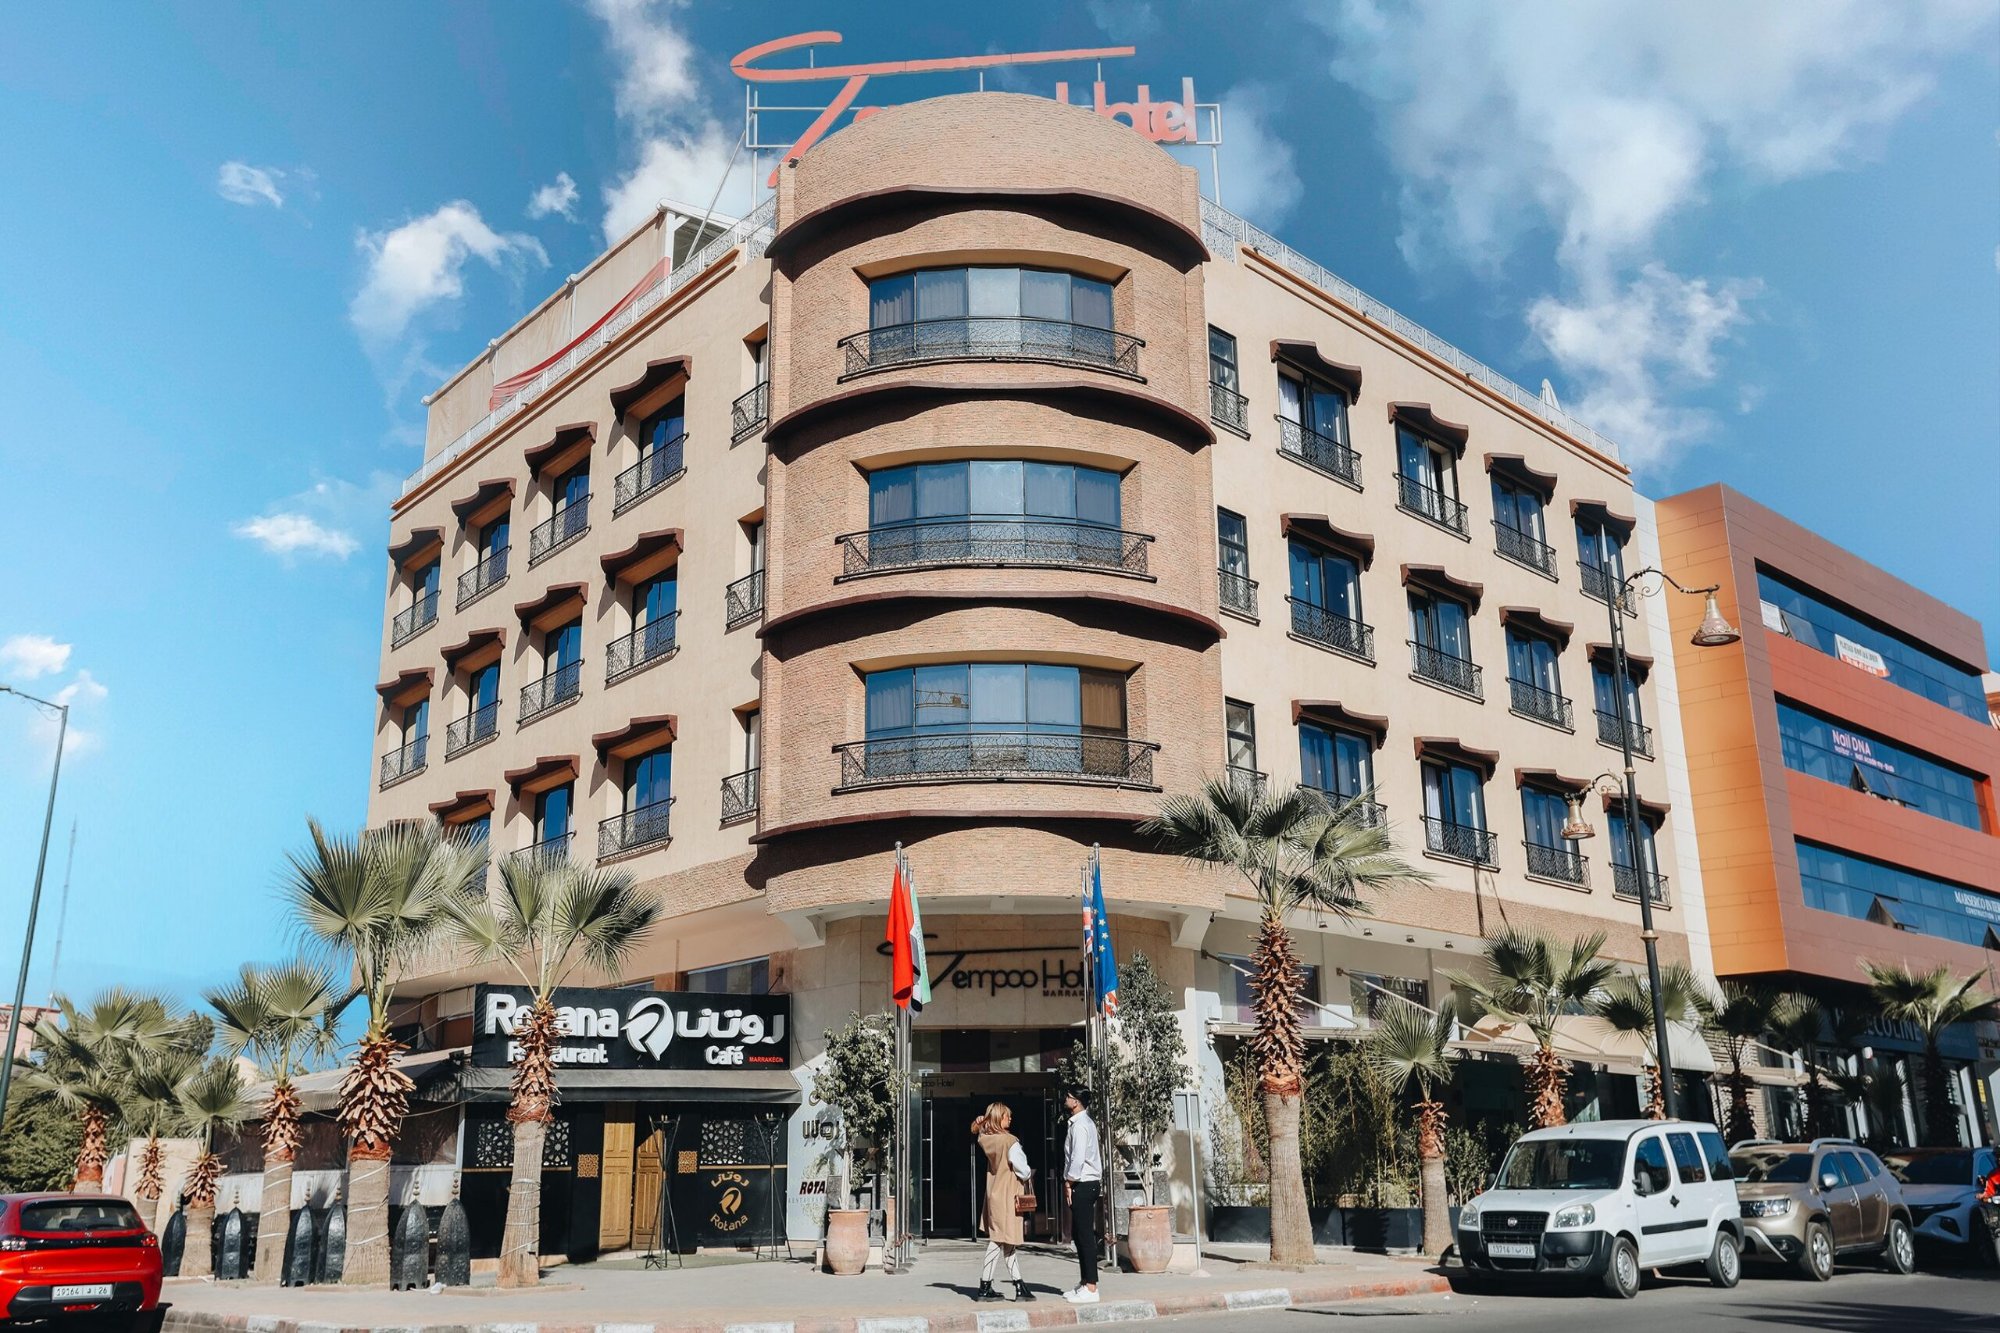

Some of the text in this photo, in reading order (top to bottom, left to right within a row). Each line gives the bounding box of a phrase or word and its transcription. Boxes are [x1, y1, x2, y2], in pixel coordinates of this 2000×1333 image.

[1852, 736, 1872, 756] DNA
[485, 993, 620, 1037] Roana
[507, 1041, 608, 1064] Reaurant
[705, 1045, 745, 1065] Café
[799, 1181, 827, 1195] ROTA
[710, 1213, 748, 1231] Rotana
